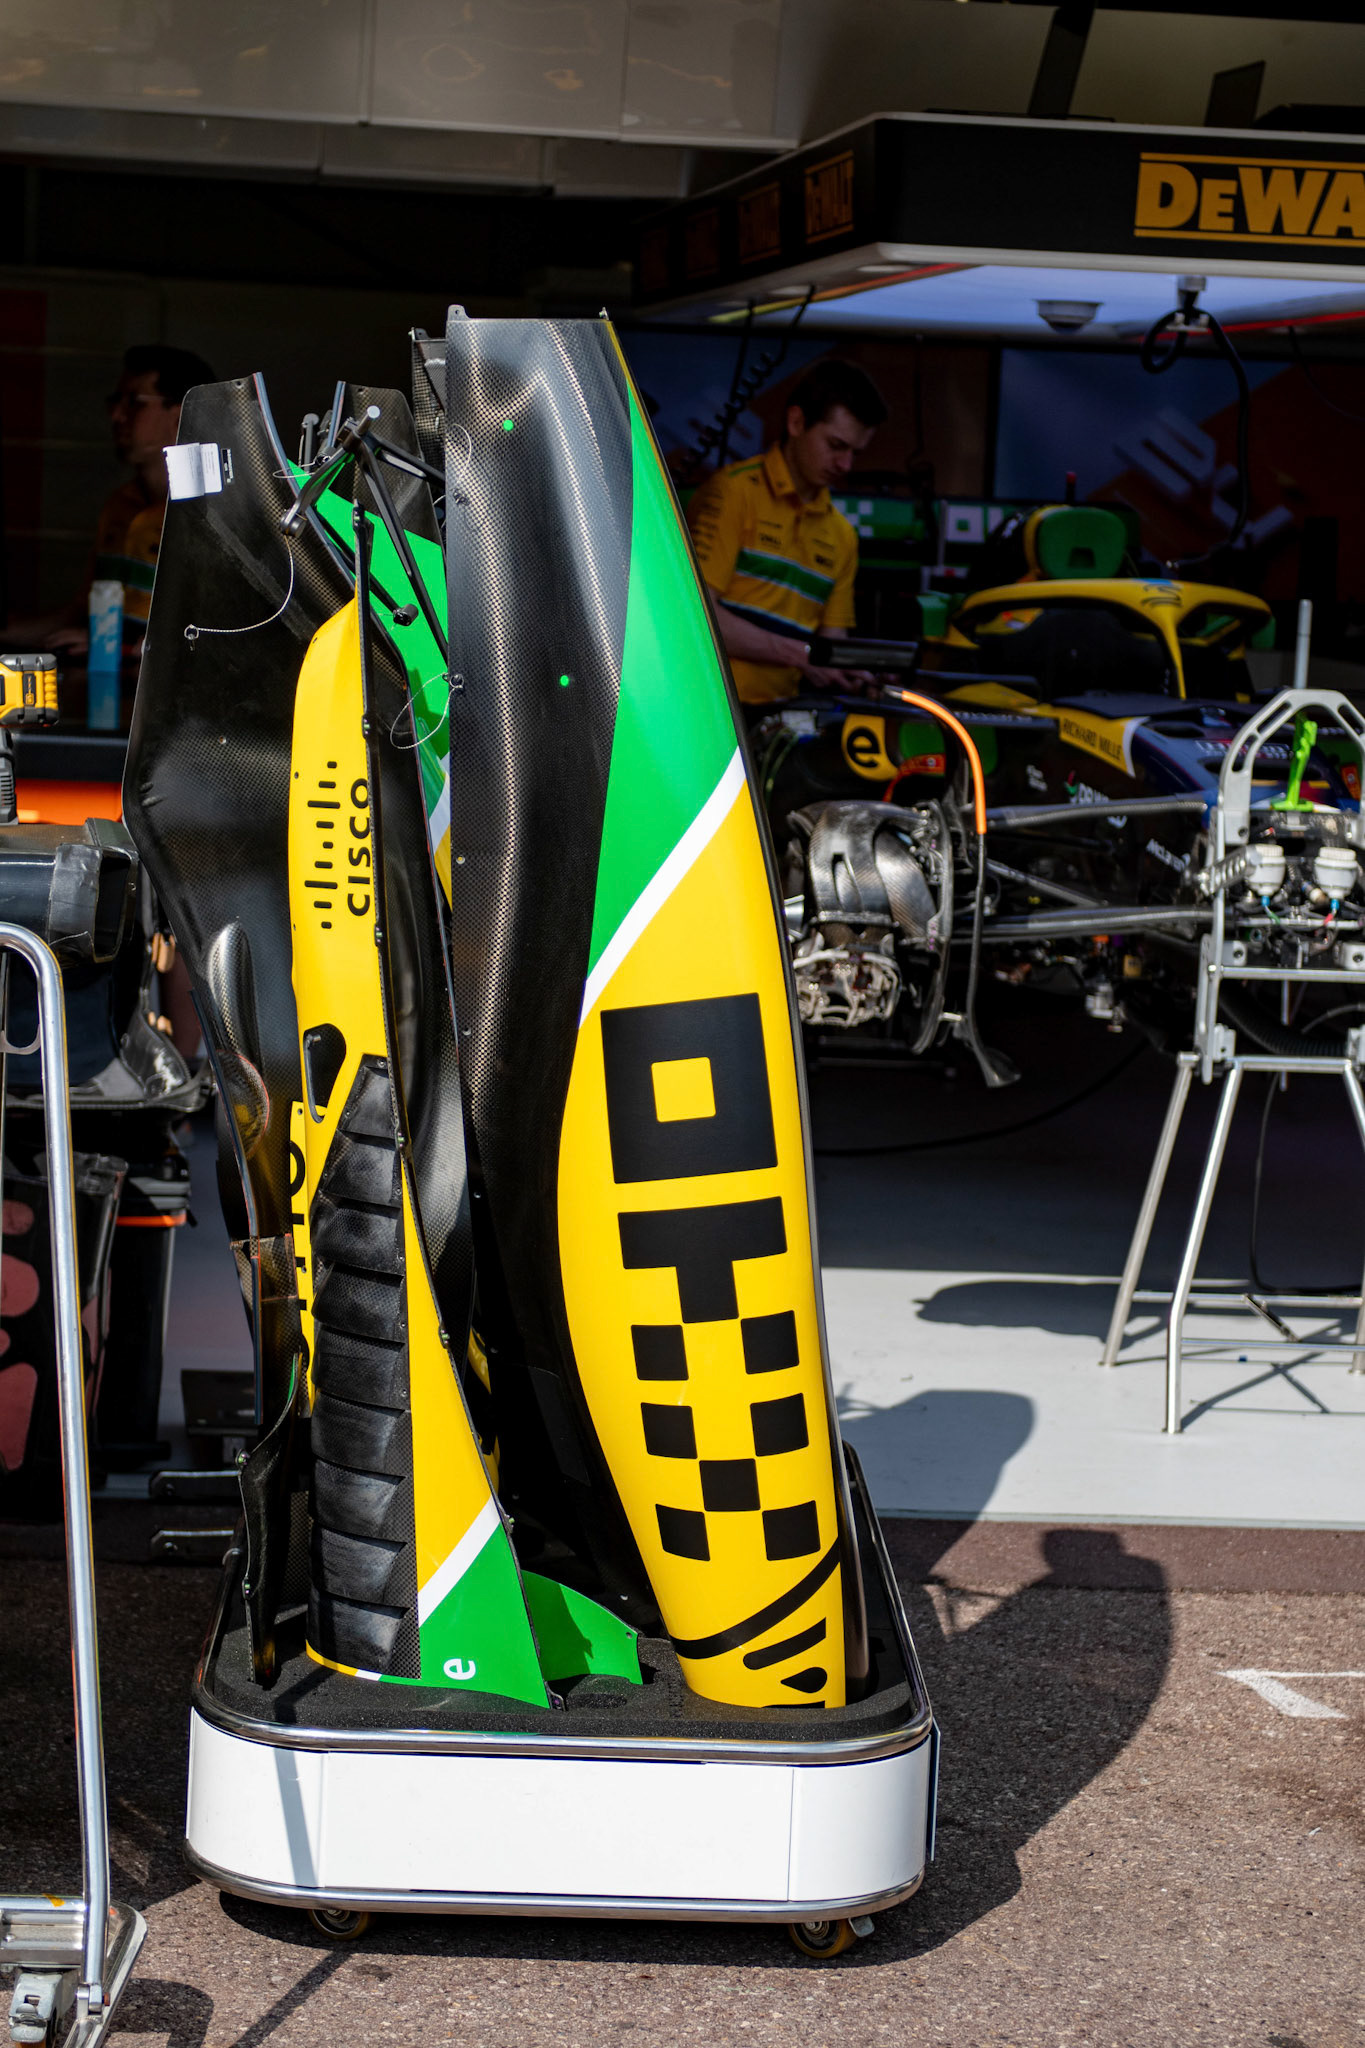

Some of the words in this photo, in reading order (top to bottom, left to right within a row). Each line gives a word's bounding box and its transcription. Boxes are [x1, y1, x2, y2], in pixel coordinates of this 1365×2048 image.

[846, 726, 880, 768] e
[1063, 717, 1098, 748] RICHARD
[1099, 735, 1123, 762] MILLE
[443, 1658, 476, 1681] e
